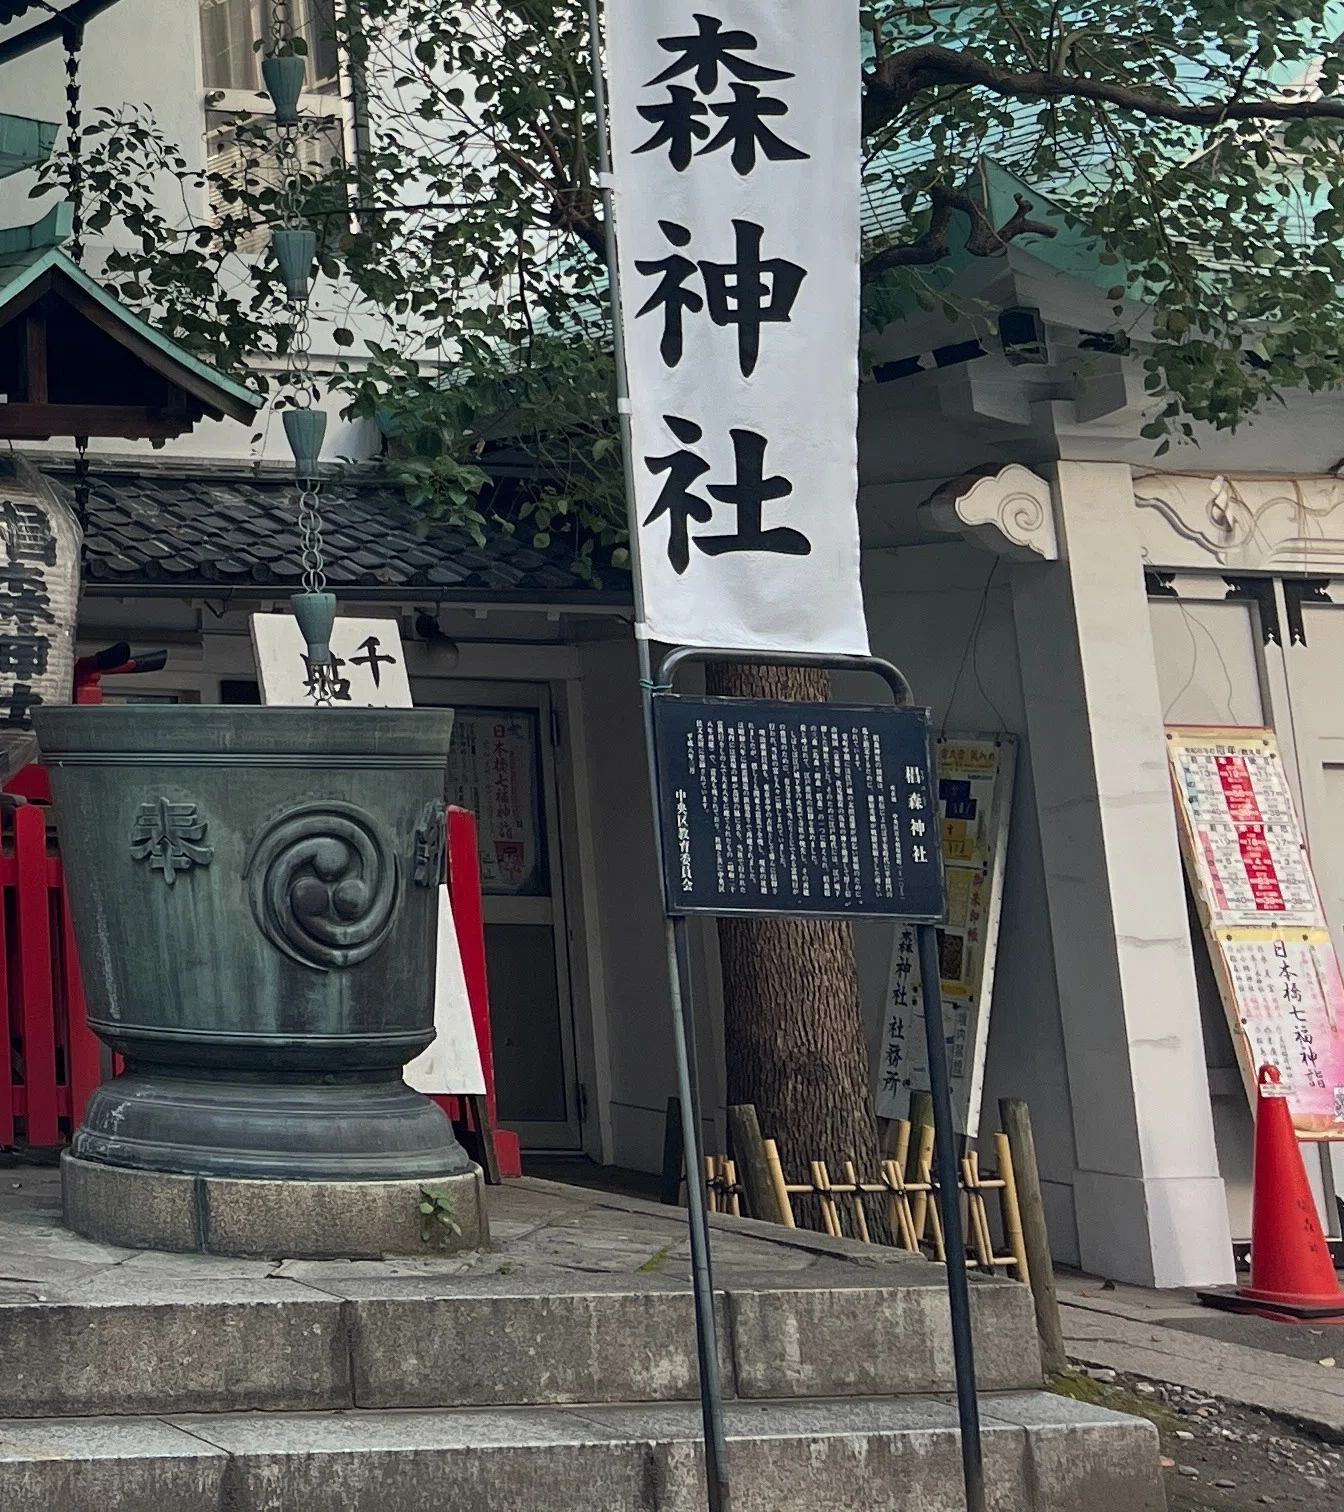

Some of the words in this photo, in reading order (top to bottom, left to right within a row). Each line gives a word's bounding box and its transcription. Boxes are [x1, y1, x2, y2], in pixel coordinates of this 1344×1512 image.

[675, 787, 693, 892] 中央区教育委員会
[1273, 939, 1326, 1089] 日本橋七福神詣
